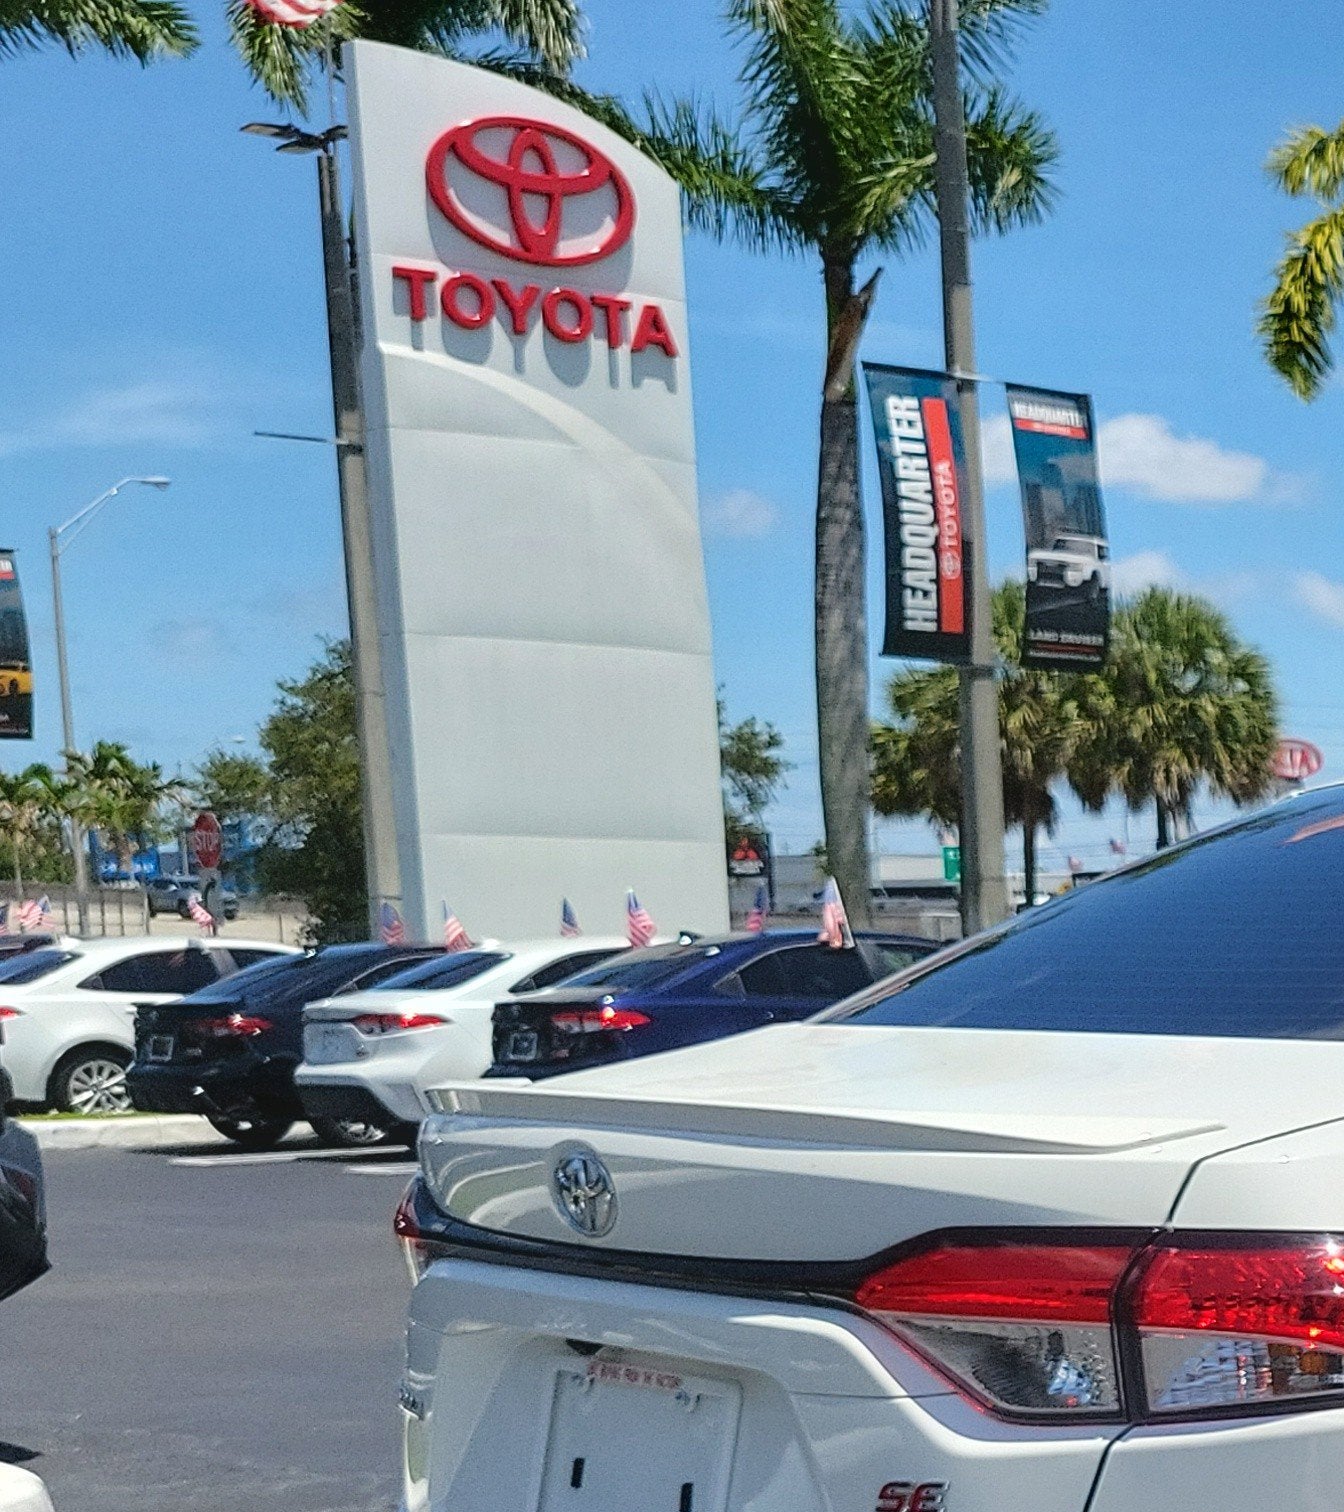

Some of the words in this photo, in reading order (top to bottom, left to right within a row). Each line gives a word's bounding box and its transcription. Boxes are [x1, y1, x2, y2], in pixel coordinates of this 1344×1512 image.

[392, 265, 679, 358] TOYOTA
[885, 395, 940, 633] HEADQUARTER
[934, 461, 958, 547] TOYOTA
